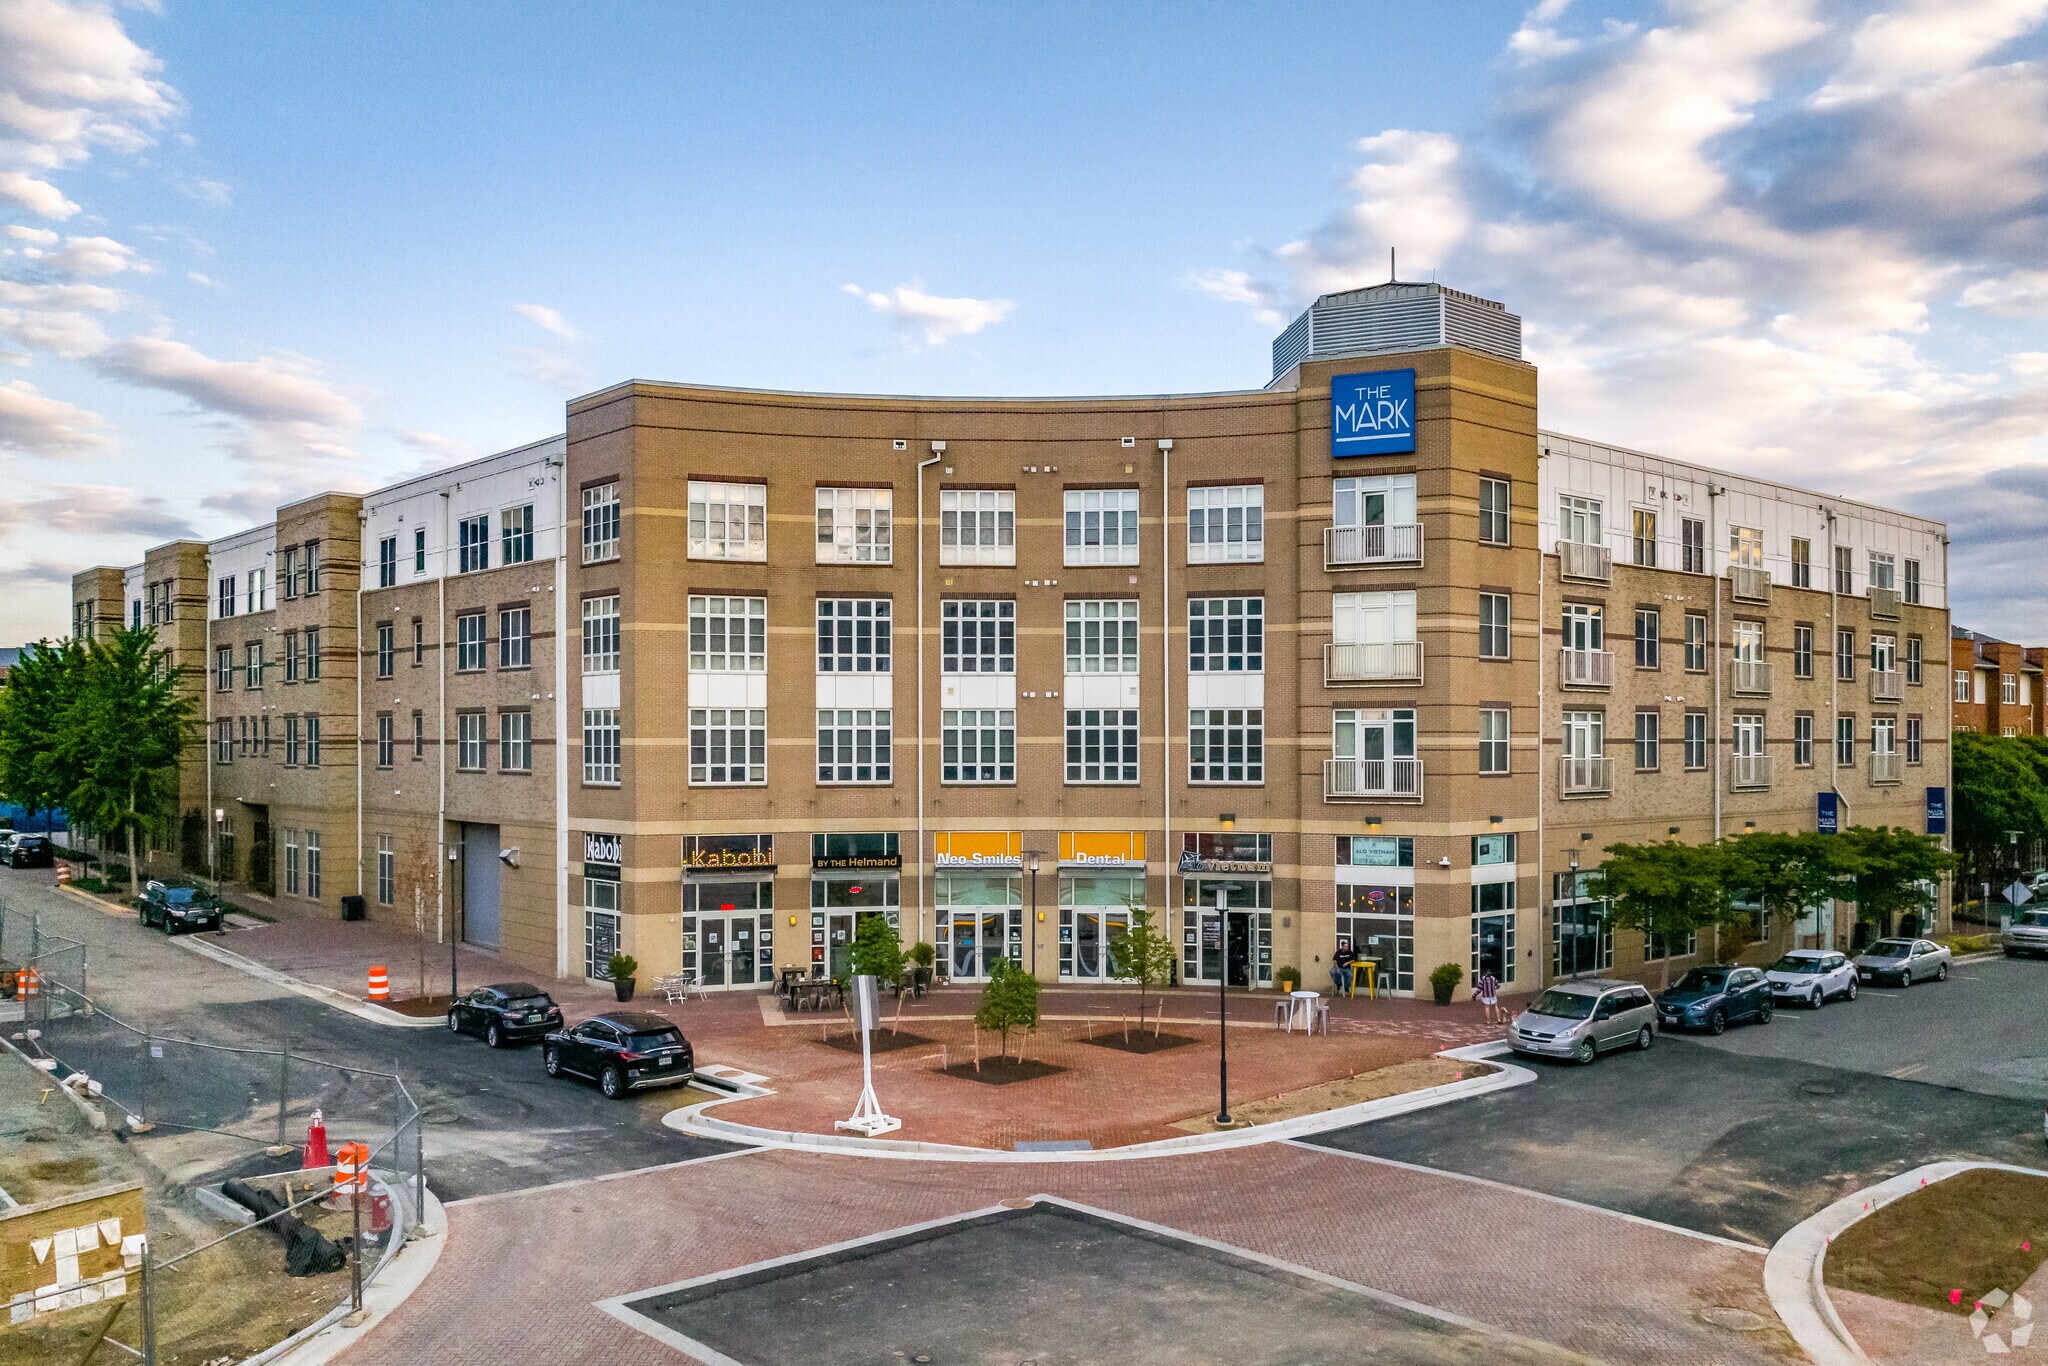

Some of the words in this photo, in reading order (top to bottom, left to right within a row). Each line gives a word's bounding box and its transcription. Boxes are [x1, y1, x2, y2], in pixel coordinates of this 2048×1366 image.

[1354, 385, 1392, 401] THE
[1335, 398, 1411, 434] MARK
[691, 847, 772, 868] Kabobi
[817, 860, 828, 868] BY
[831, 859, 847, 867] THE
[849, 857, 897, 867] Helmand
[937, 852, 967, 865] Neo
[972, 852, 1021, 865] Smiles
[1076, 852, 1125, 866] Dental
